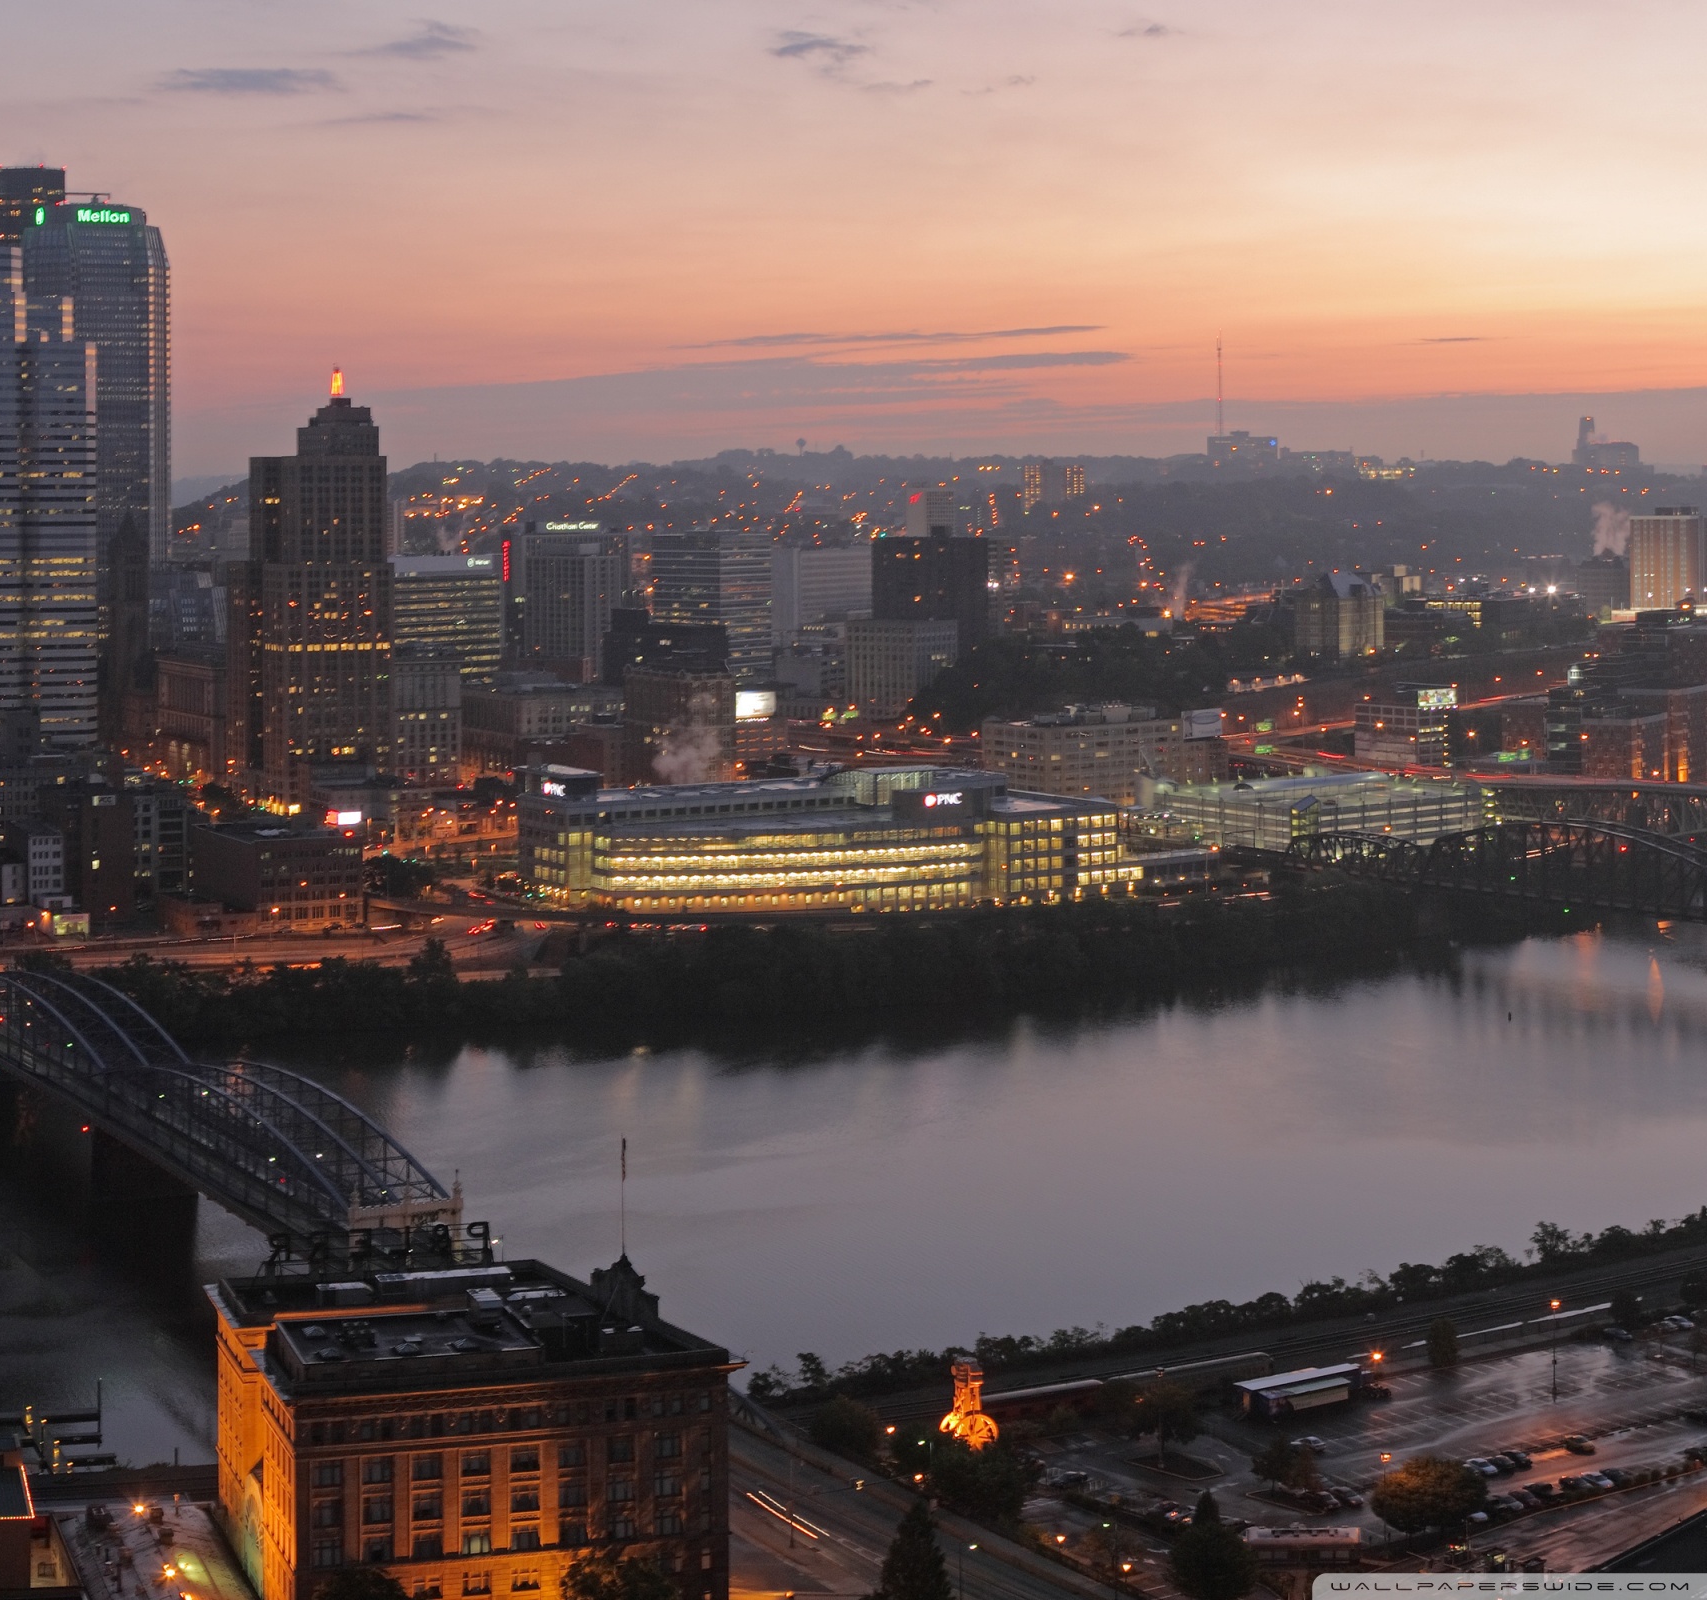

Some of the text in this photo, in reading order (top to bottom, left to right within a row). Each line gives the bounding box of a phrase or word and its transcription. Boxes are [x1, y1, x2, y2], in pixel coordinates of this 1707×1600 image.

[77, 209, 130, 223] Mellon
[550, 782, 567, 797] PNC
[937, 792, 963, 805] PNC
